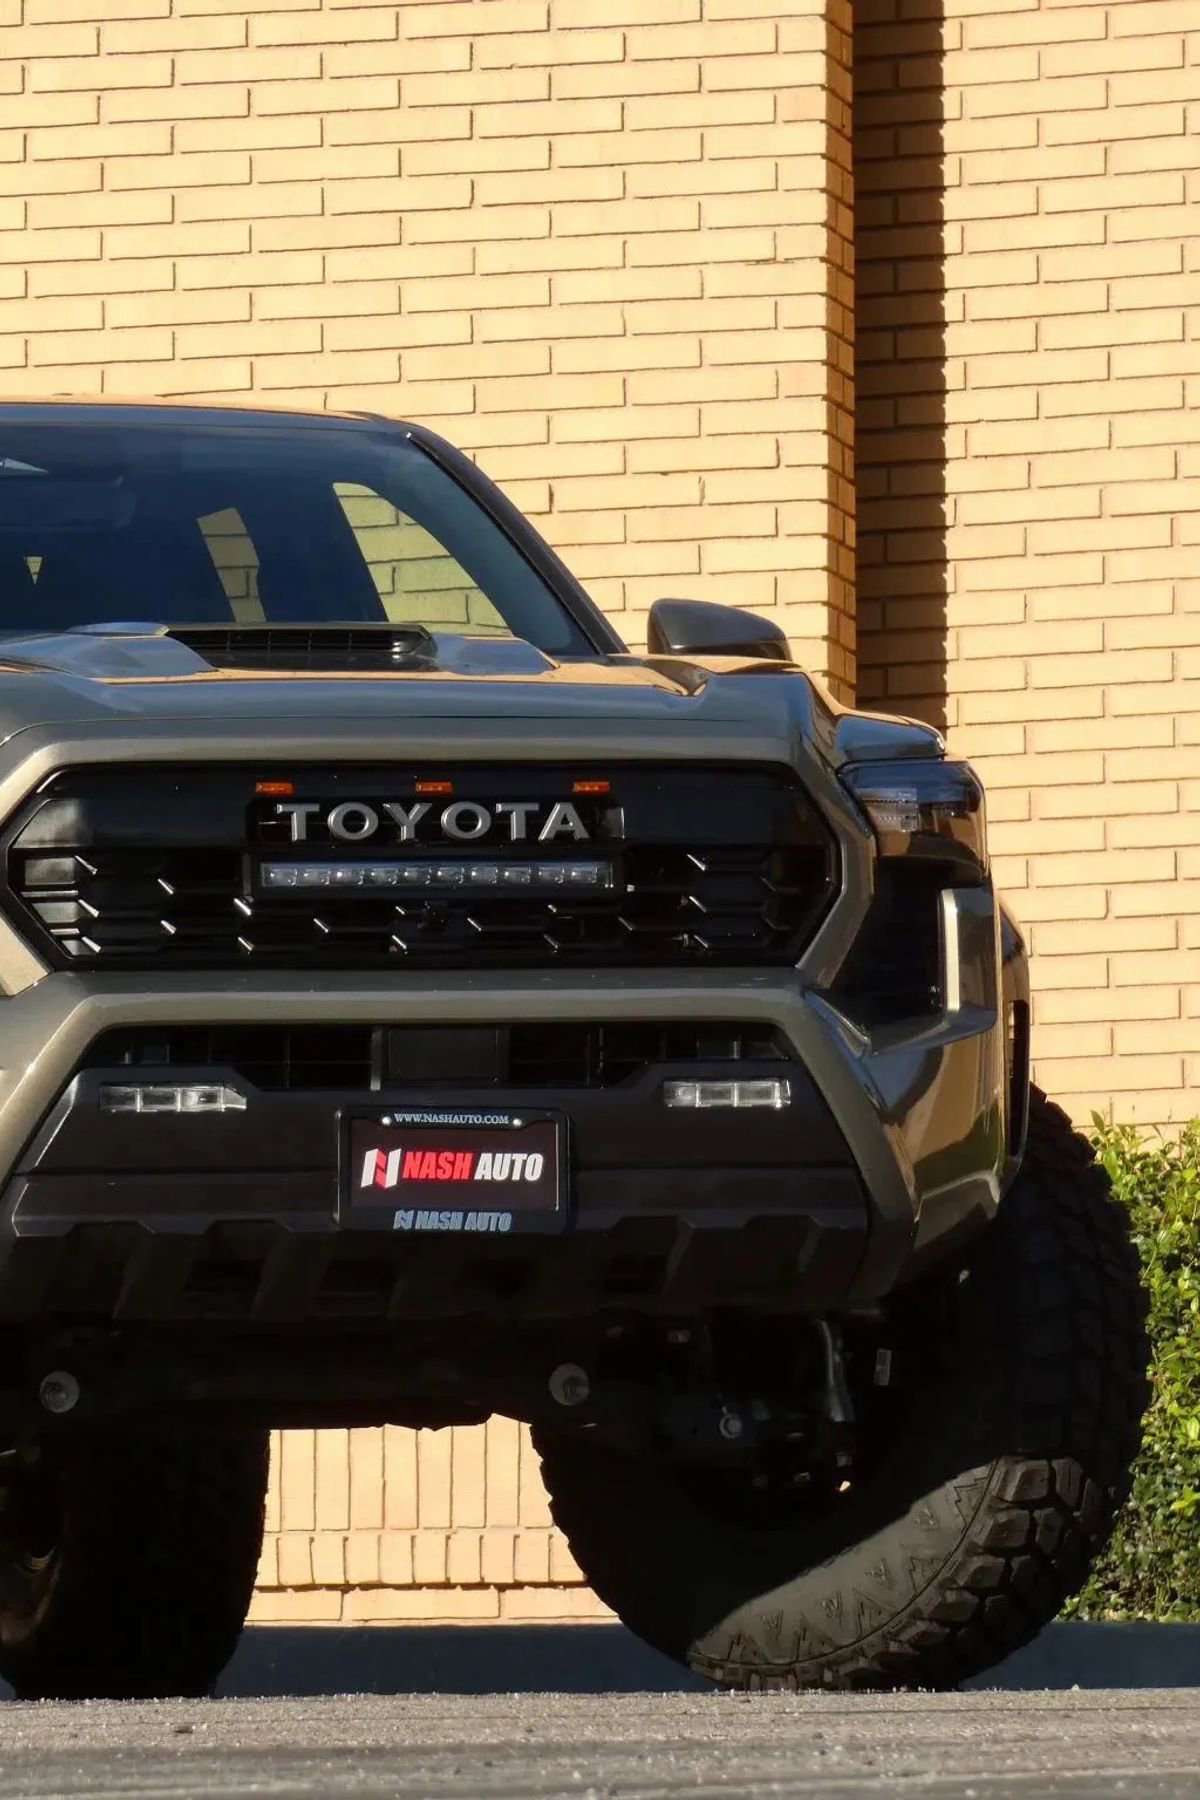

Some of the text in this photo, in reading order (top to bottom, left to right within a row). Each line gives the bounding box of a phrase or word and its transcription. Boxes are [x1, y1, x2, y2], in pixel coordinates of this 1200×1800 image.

[277, 802, 590, 842] TOYOTA
[394, 1113, 509, 1125] WWW.NASHAUTO.COM
[402, 1151, 474, 1180] NASH
[474, 1152, 544, 1181] AUTO
[415, 1211, 463, 1230] NASH
[464, 1212, 513, 1232] AUTO
